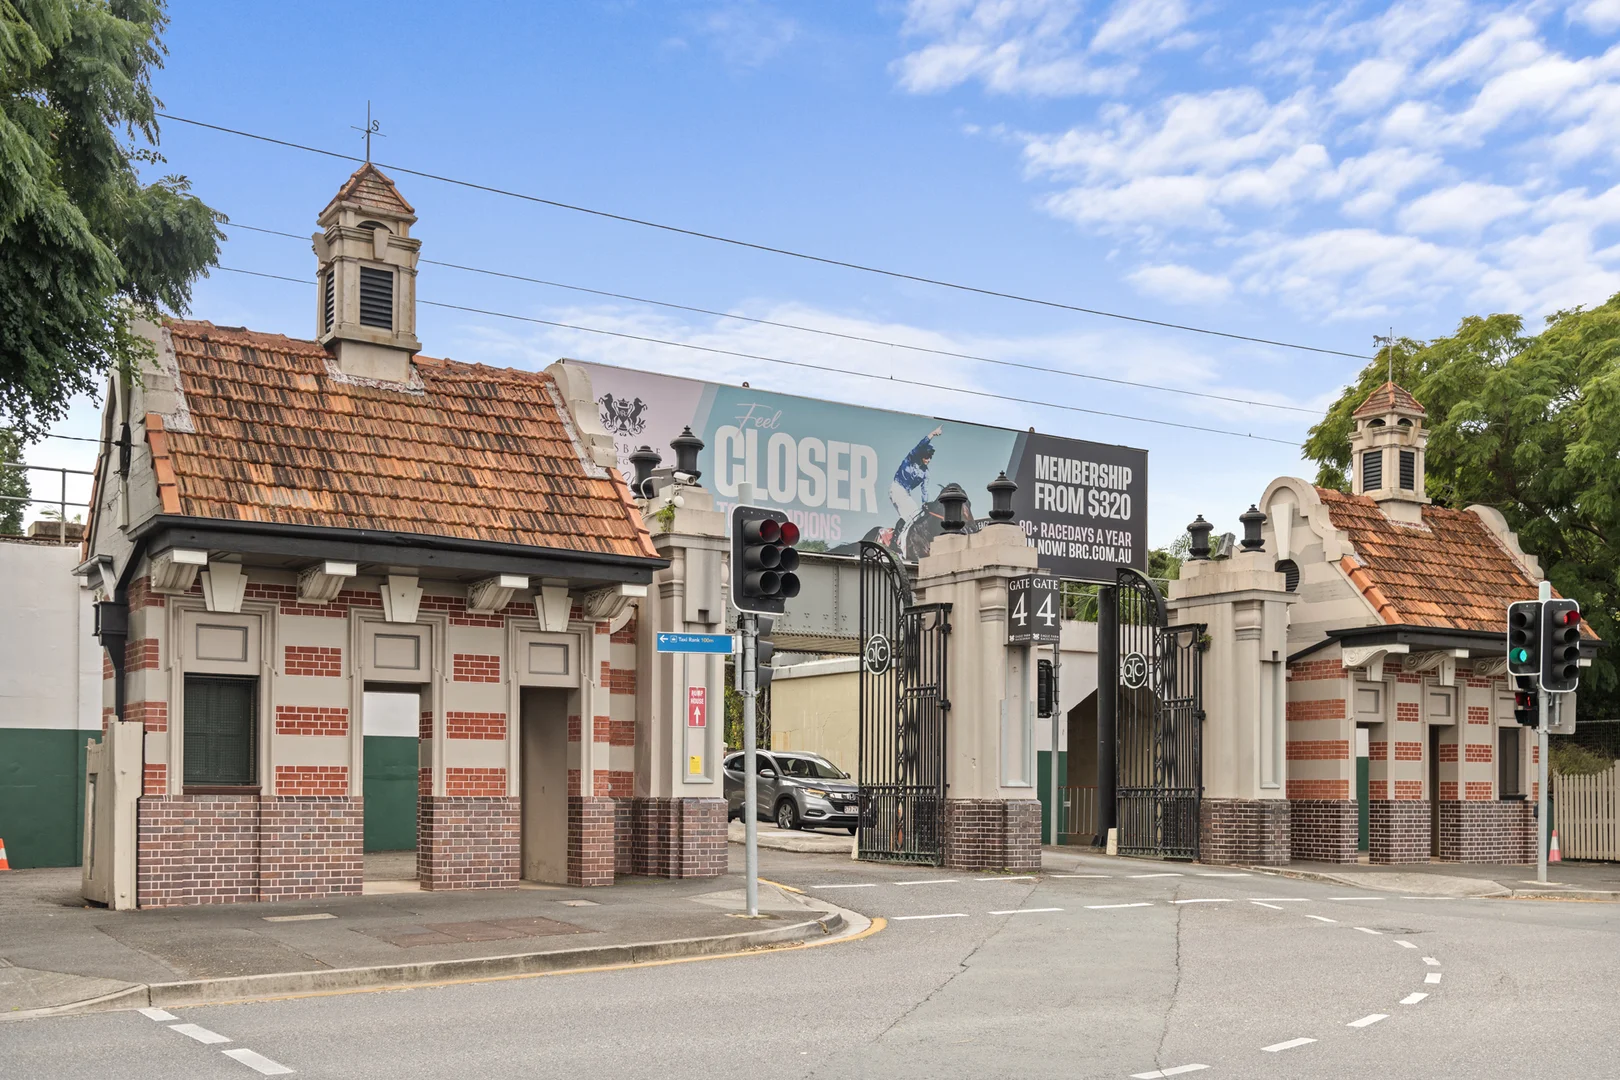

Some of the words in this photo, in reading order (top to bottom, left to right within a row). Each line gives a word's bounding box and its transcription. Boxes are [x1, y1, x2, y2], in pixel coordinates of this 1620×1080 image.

[372, 119, 380, 132] S
[734, 402, 783, 439] Feel
[714, 424, 879, 514] CLOSER
[1035, 453, 1133, 491] MEMBERSHIP
[1034, 481, 1085, 516] FROM
[1087, 486, 1132, 521] $320
[787, 508, 842, 541] PIONS
[1040, 521, 1095, 544] RACEDAYS
[1096, 528, 1104, 544] A
[1105, 529, 1132, 548] YEAR
[1037, 538, 1066, 558] NOW!
[1068, 542, 1132, 564] BRC.COM.AU
[1009, 578, 1030, 591] GATE
[1032, 577, 1059, 590] GATE
[1011, 591, 1028, 627] 4
[1035, 592, 1056, 627] 4
